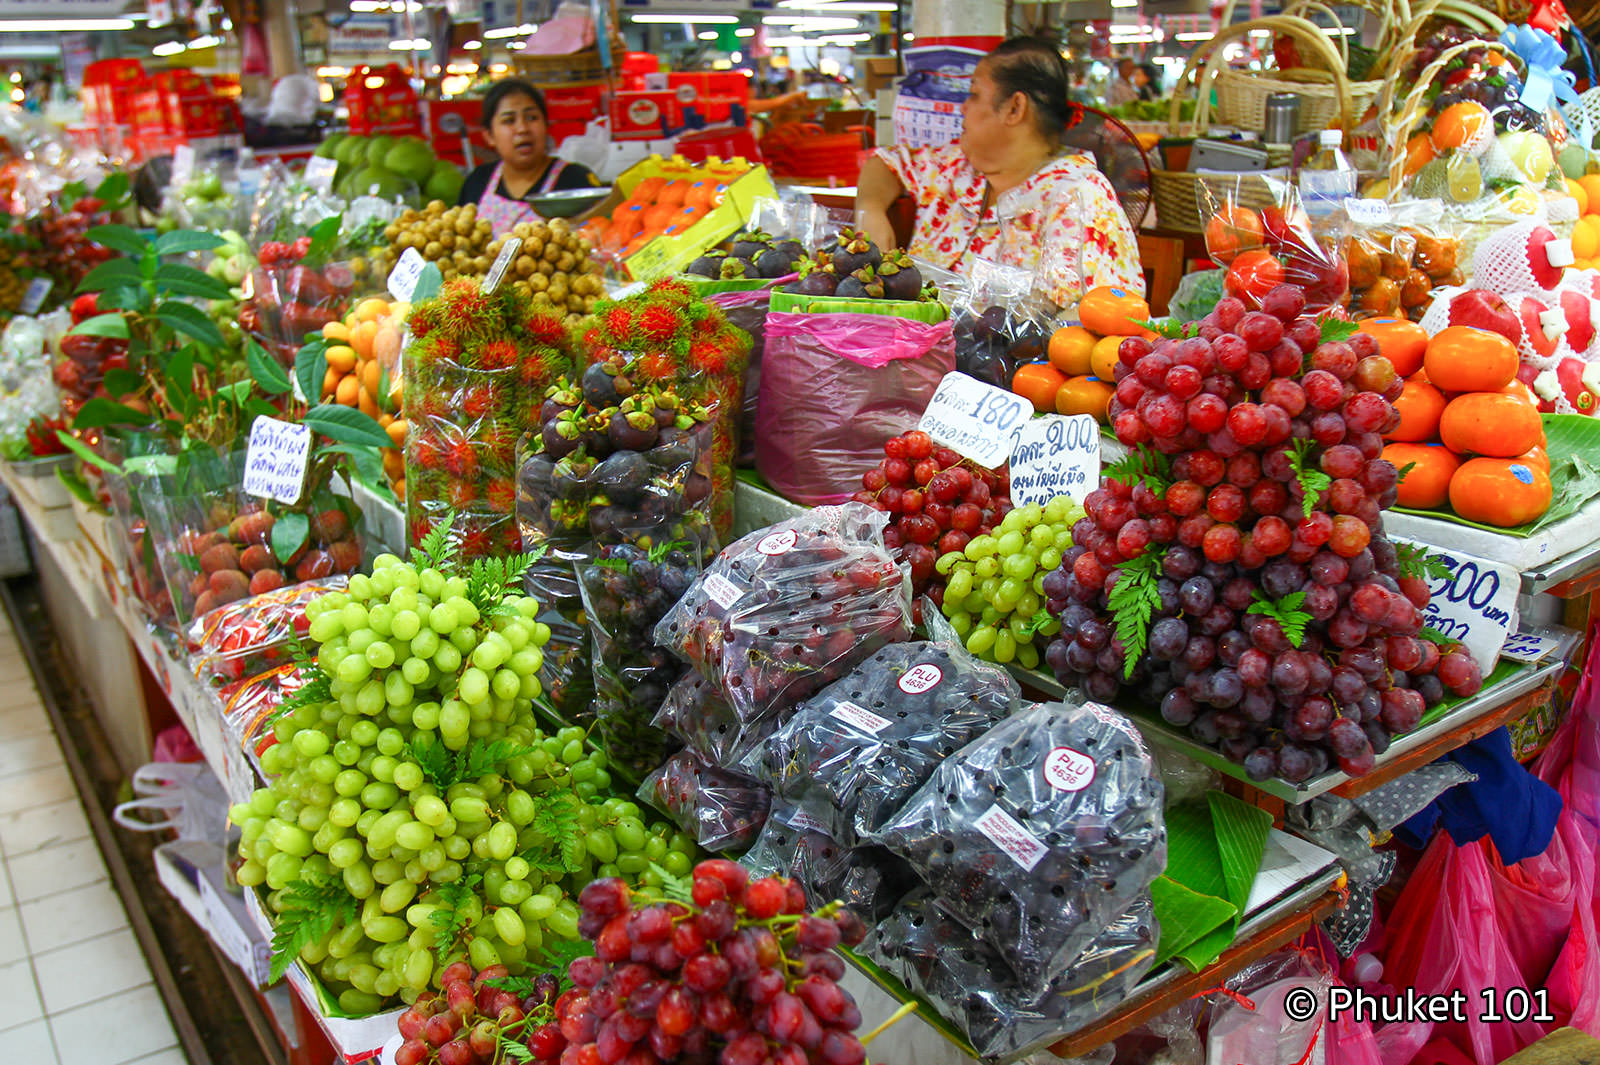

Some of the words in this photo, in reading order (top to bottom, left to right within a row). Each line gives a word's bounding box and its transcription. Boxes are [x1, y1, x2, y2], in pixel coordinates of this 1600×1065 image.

[968, 388, 1021, 430] 180
[1046, 417, 1092, 456] 200
[905, 678, 927, 690] 4636
[911, 668, 937, 682] PLU
[1051, 764, 1079, 785] 4636
[1057, 753, 1089, 776] PLU
